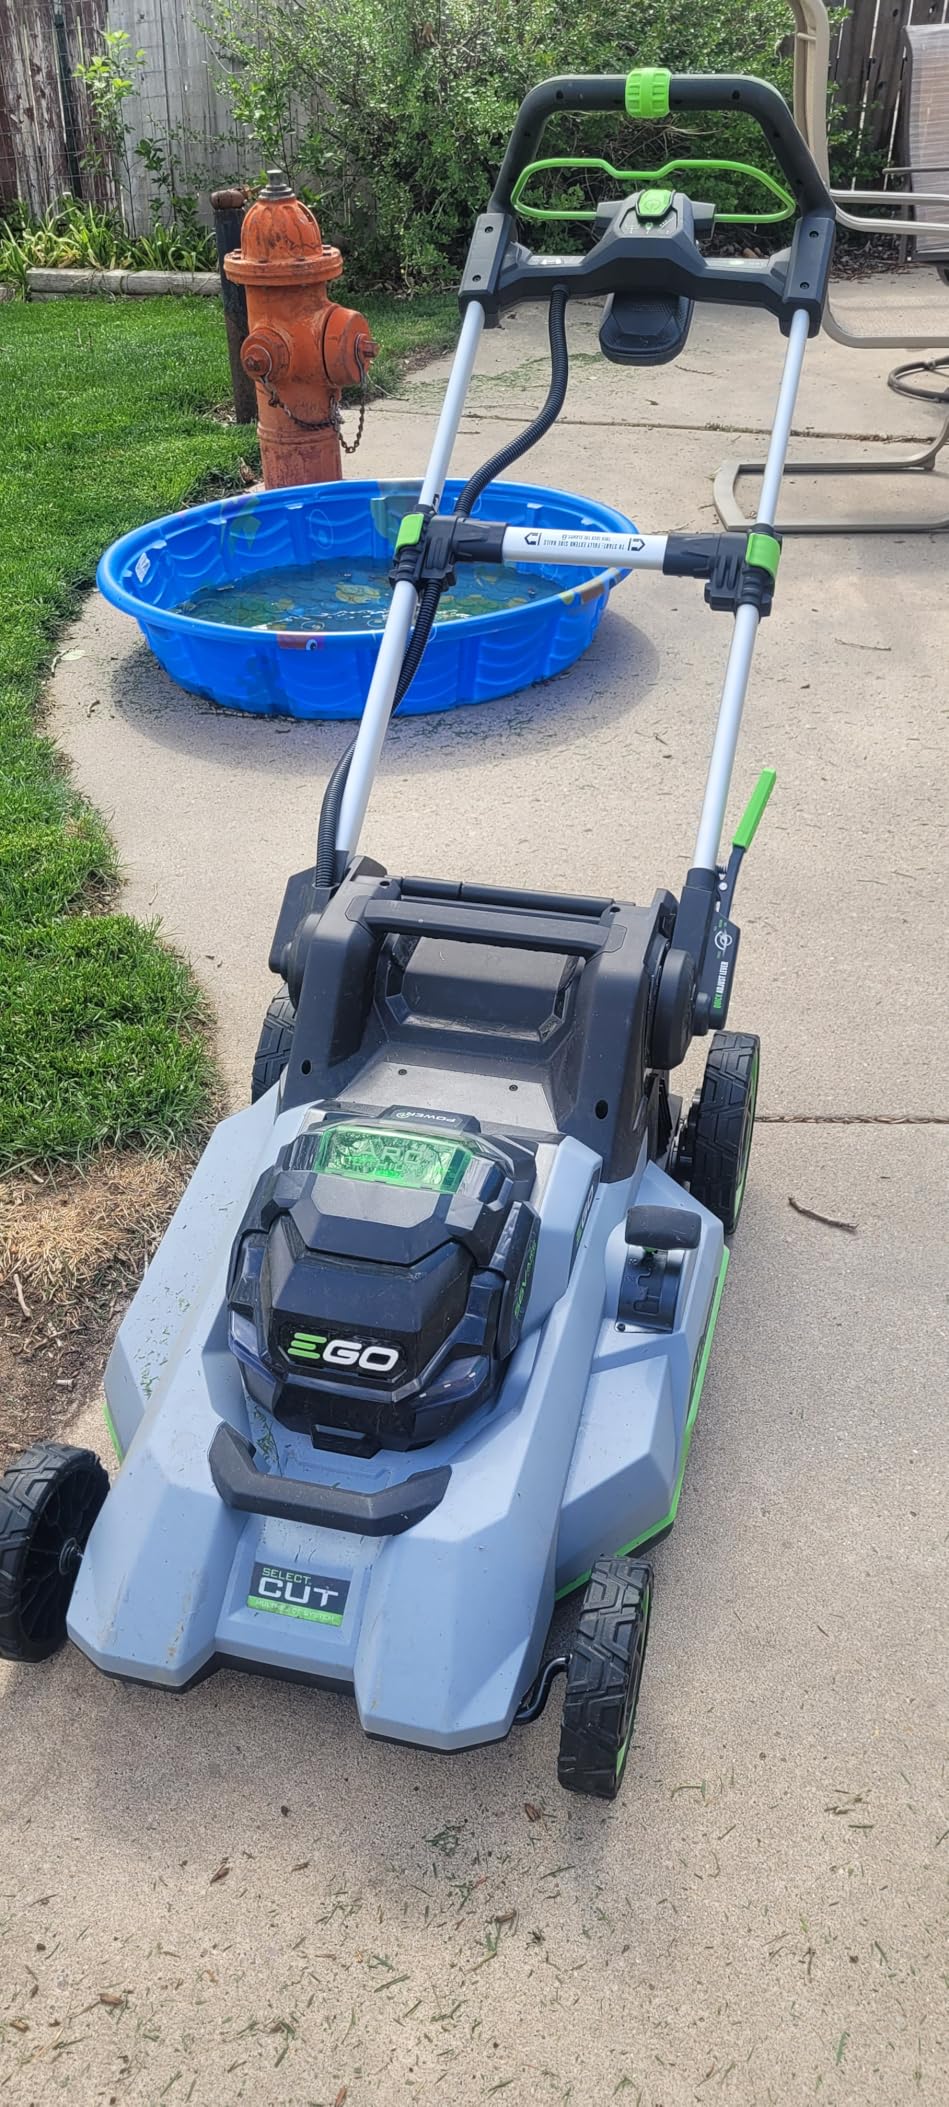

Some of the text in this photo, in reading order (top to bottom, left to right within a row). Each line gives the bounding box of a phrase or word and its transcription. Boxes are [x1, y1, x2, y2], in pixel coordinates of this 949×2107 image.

[713, 961, 729, 1008] QUICK ADJUST LEVER
[287, 1332, 399, 1372] EGO
[258, 1577, 339, 1608] CUT
[262, 1567, 312, 1585] SELECT
